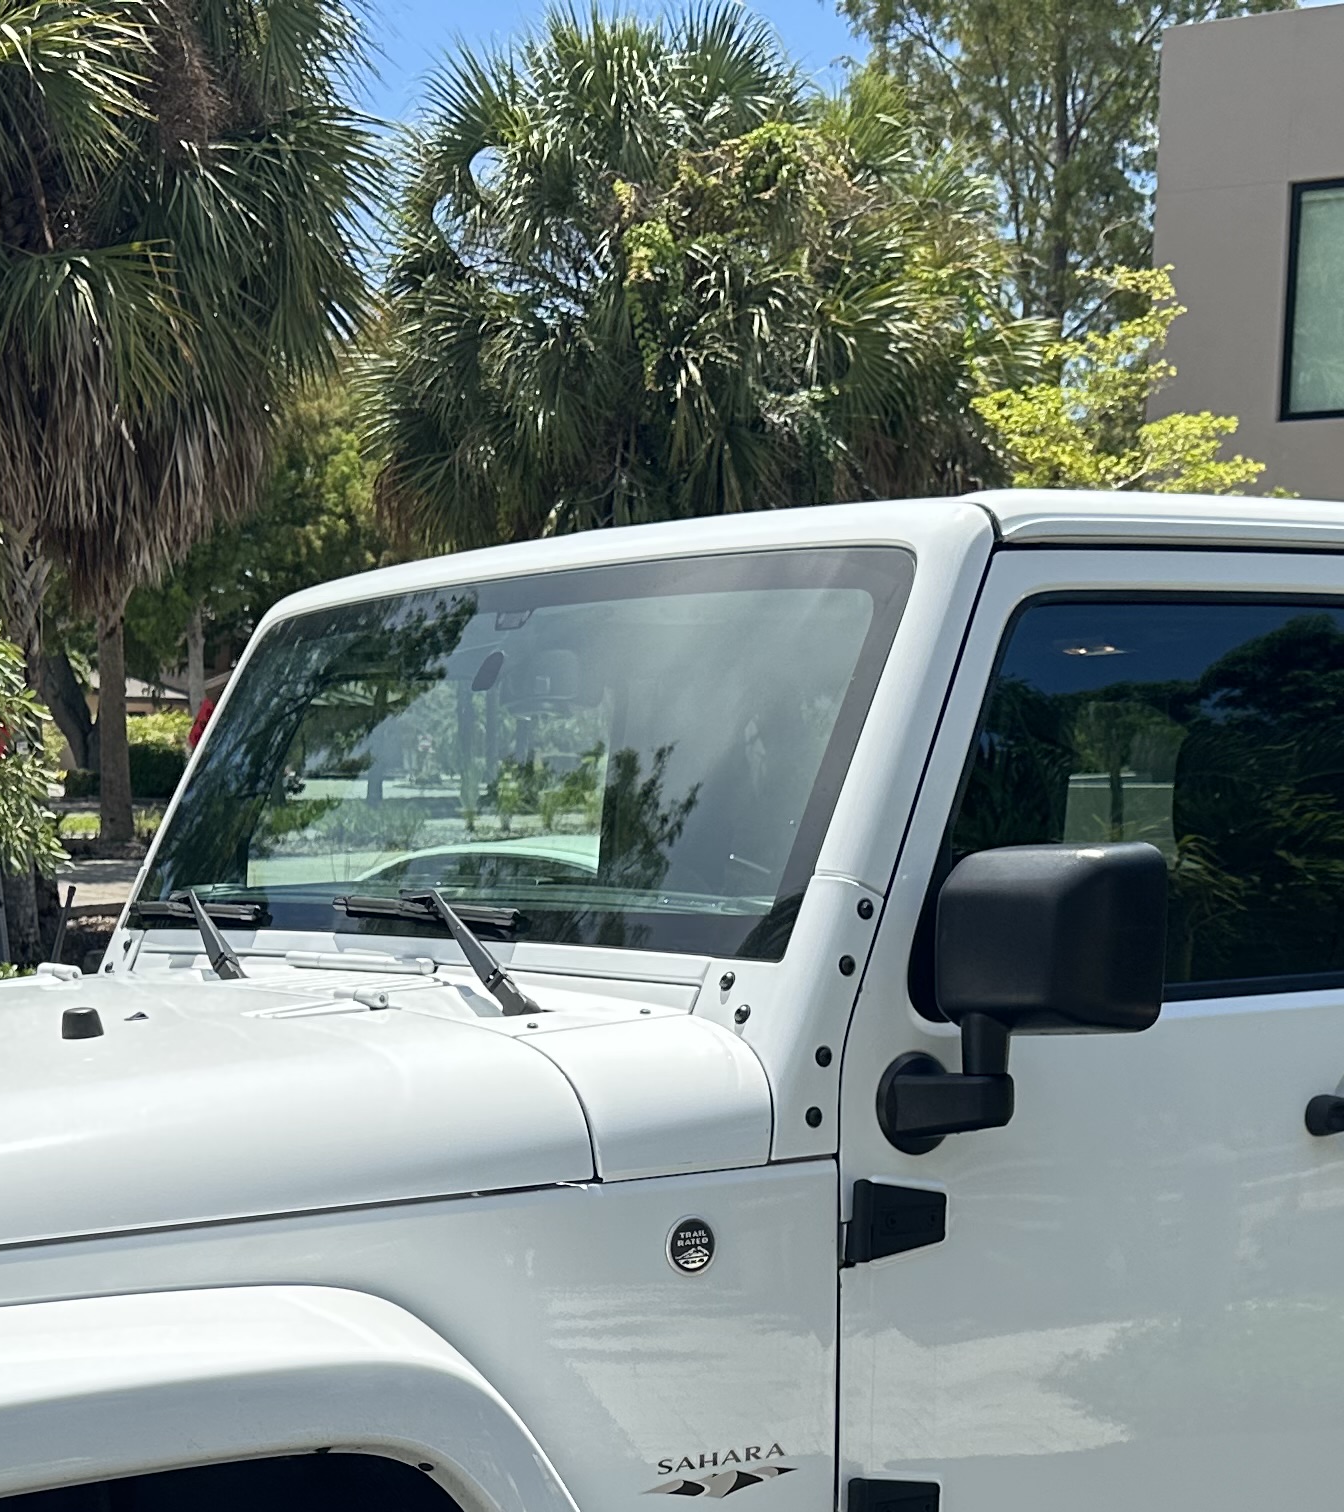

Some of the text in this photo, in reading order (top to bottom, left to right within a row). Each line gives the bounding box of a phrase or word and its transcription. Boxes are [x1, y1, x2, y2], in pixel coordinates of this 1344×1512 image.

[679, 1229, 707, 1239] TRAIL
[677, 1237, 709, 1247] RATED
[657, 1443, 786, 1475] SAHARA
